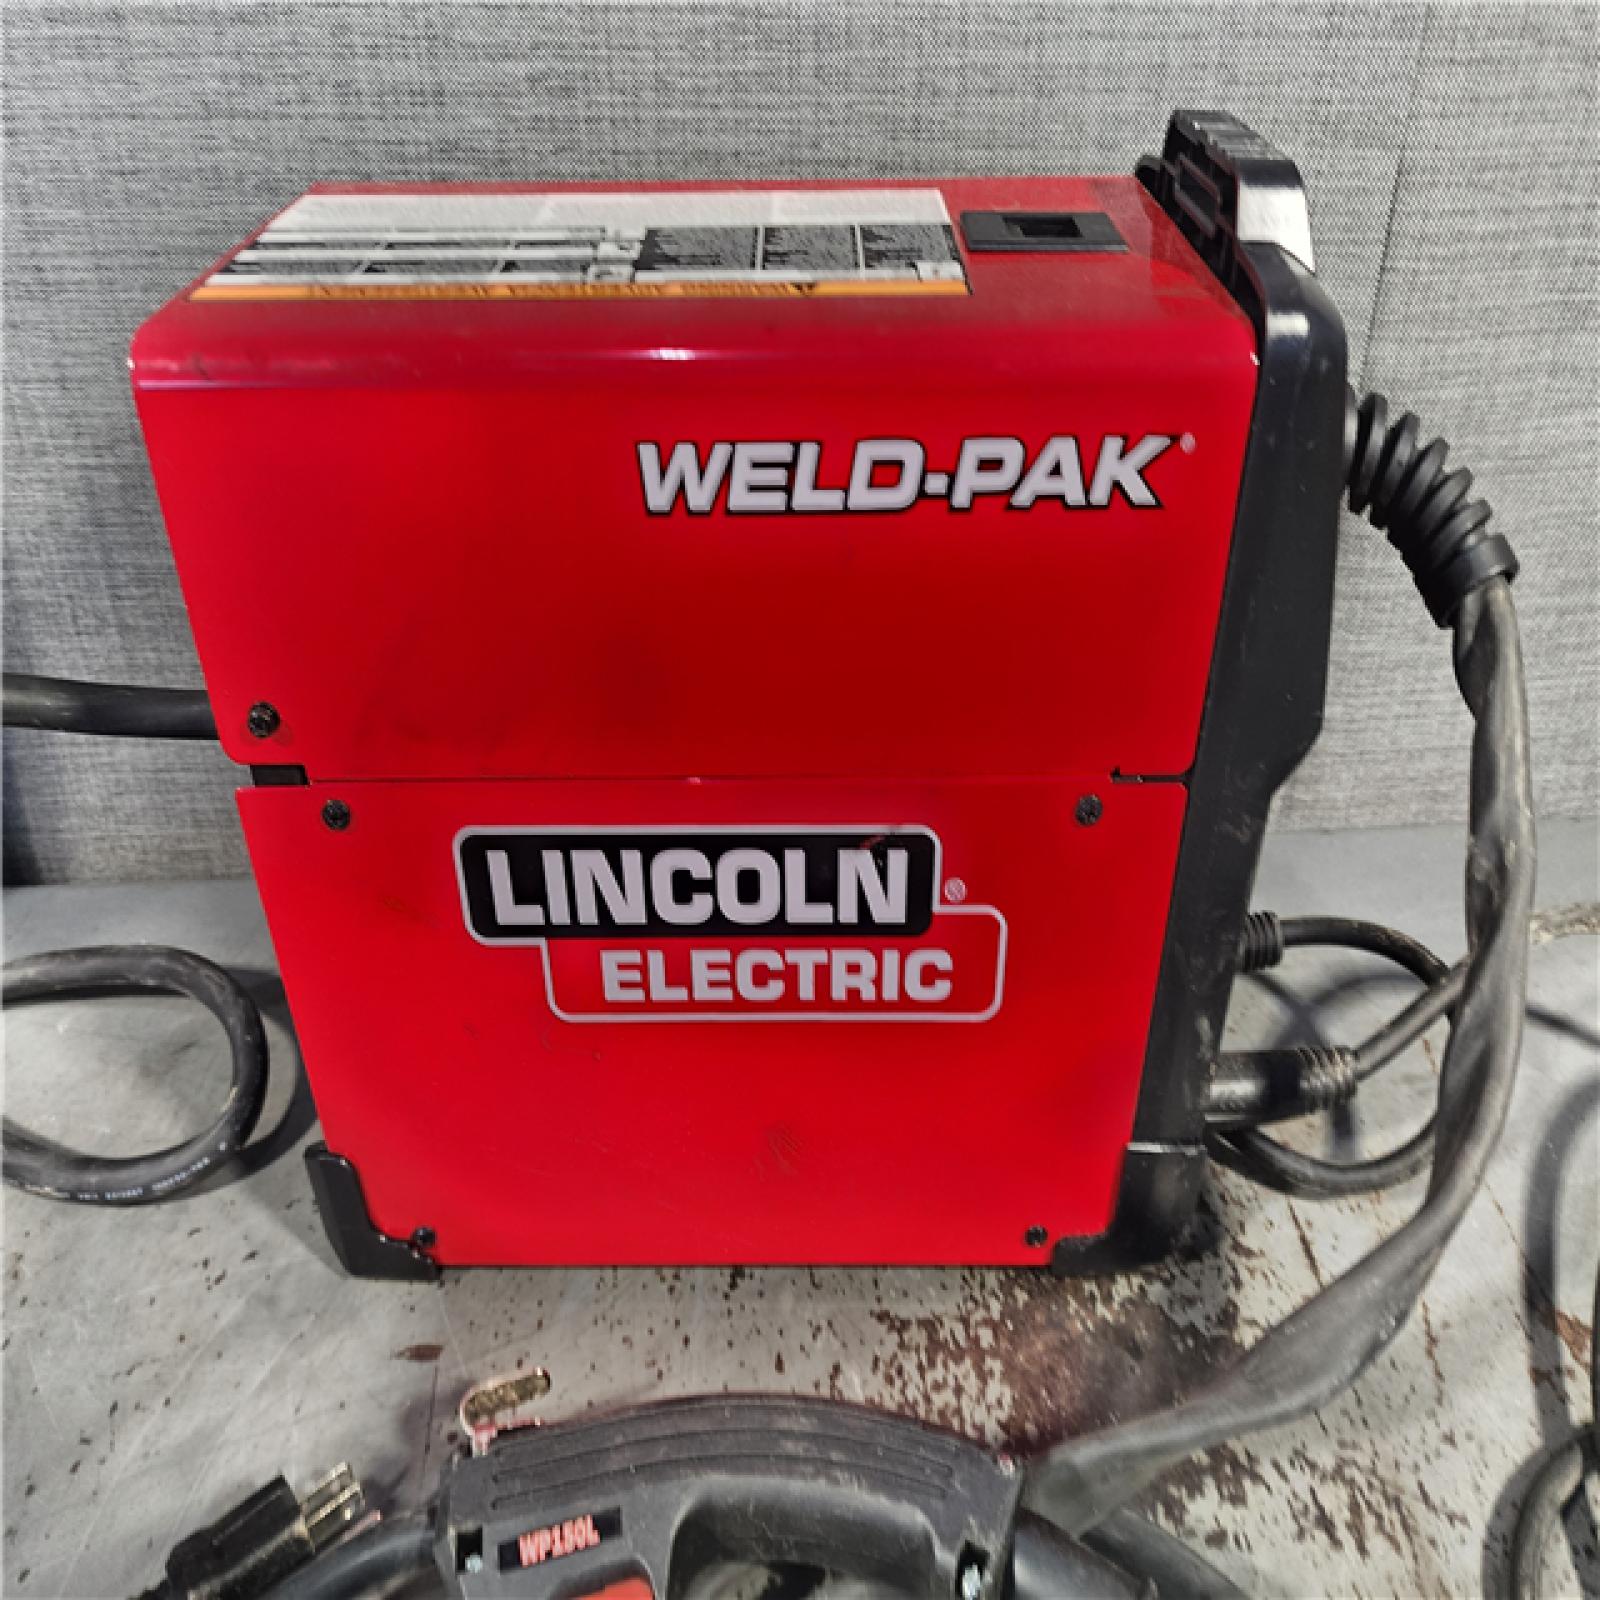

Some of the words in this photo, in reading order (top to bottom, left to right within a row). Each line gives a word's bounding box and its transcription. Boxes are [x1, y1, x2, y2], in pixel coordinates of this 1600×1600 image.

[636, 435, 1172, 515] WELD-PAK
[486, 848, 909, 926] LINCOLN
[601, 948, 954, 1003] ELECTRIC
